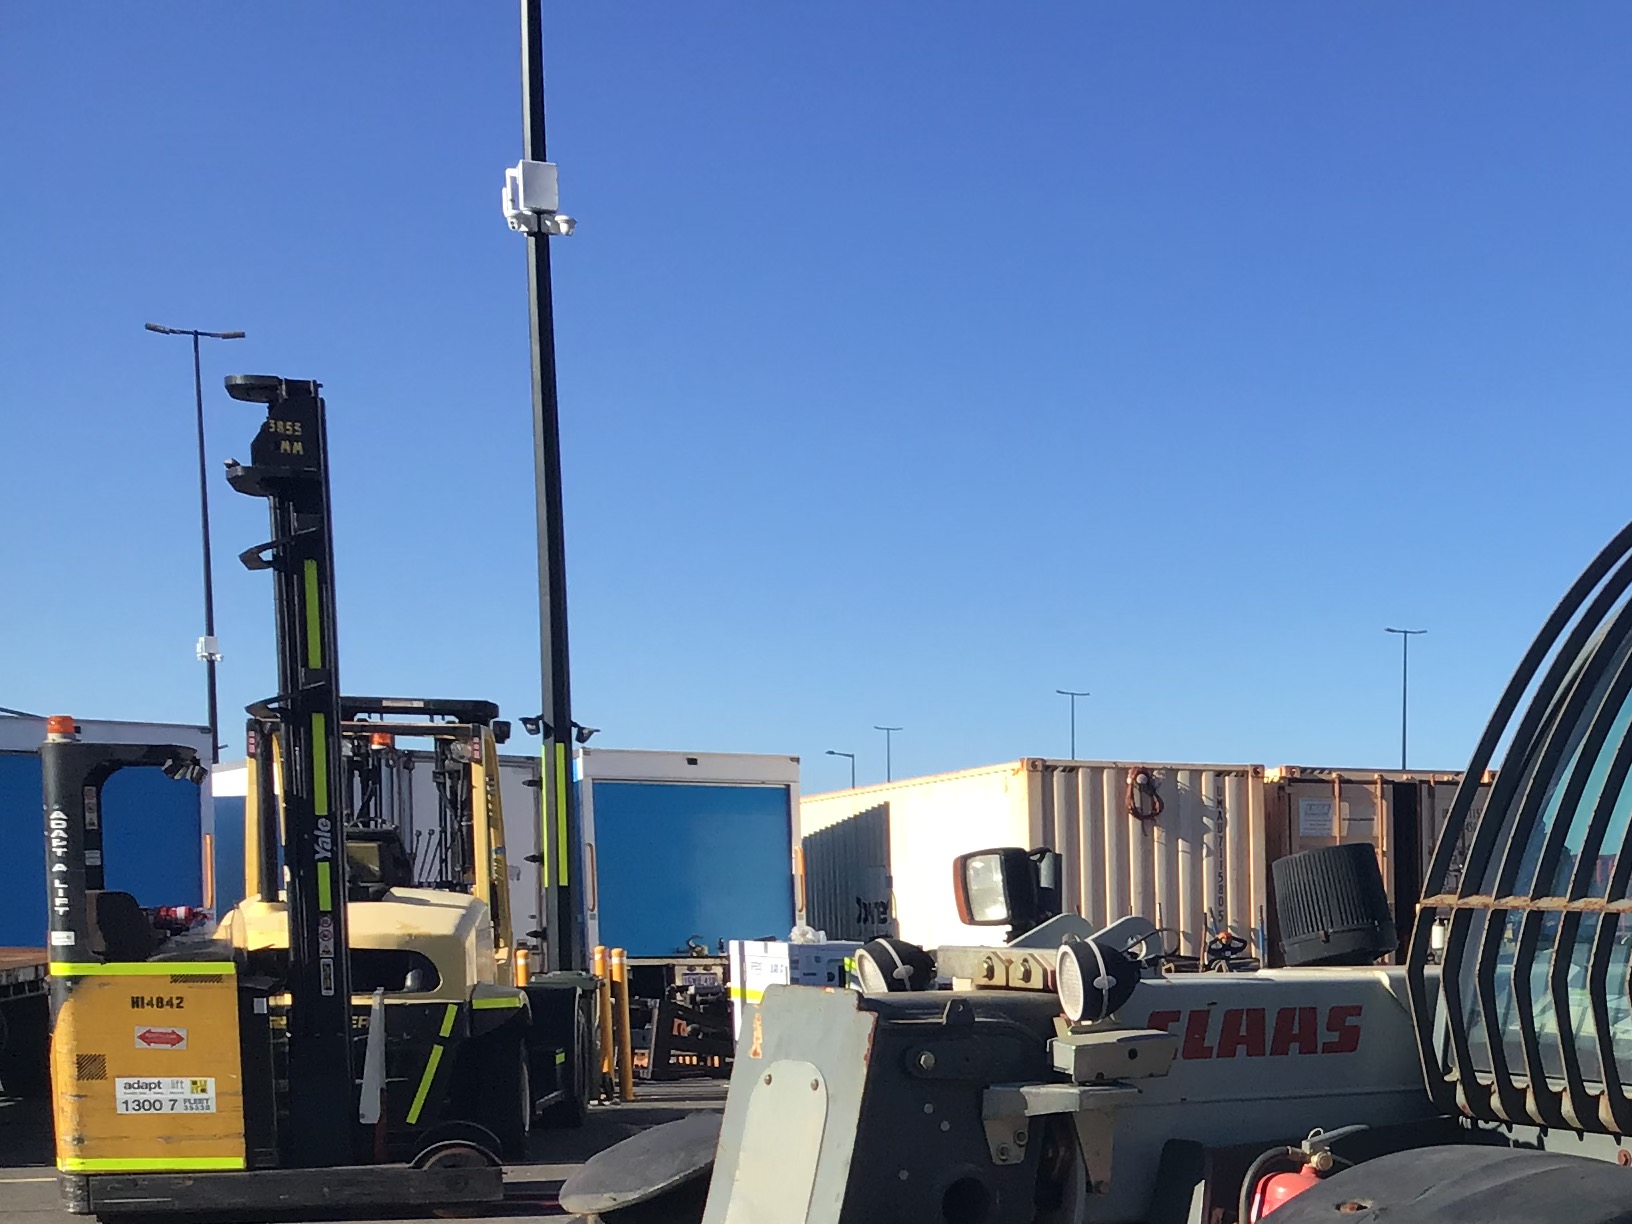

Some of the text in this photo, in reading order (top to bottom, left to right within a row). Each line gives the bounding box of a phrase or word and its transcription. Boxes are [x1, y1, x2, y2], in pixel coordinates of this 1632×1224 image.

[313, 817, 333, 862] Yale
[54, 879, 70, 916] LIFT
[123, 1079, 162, 1091] adapt
[121, 1098, 178, 1112] 1300 7
